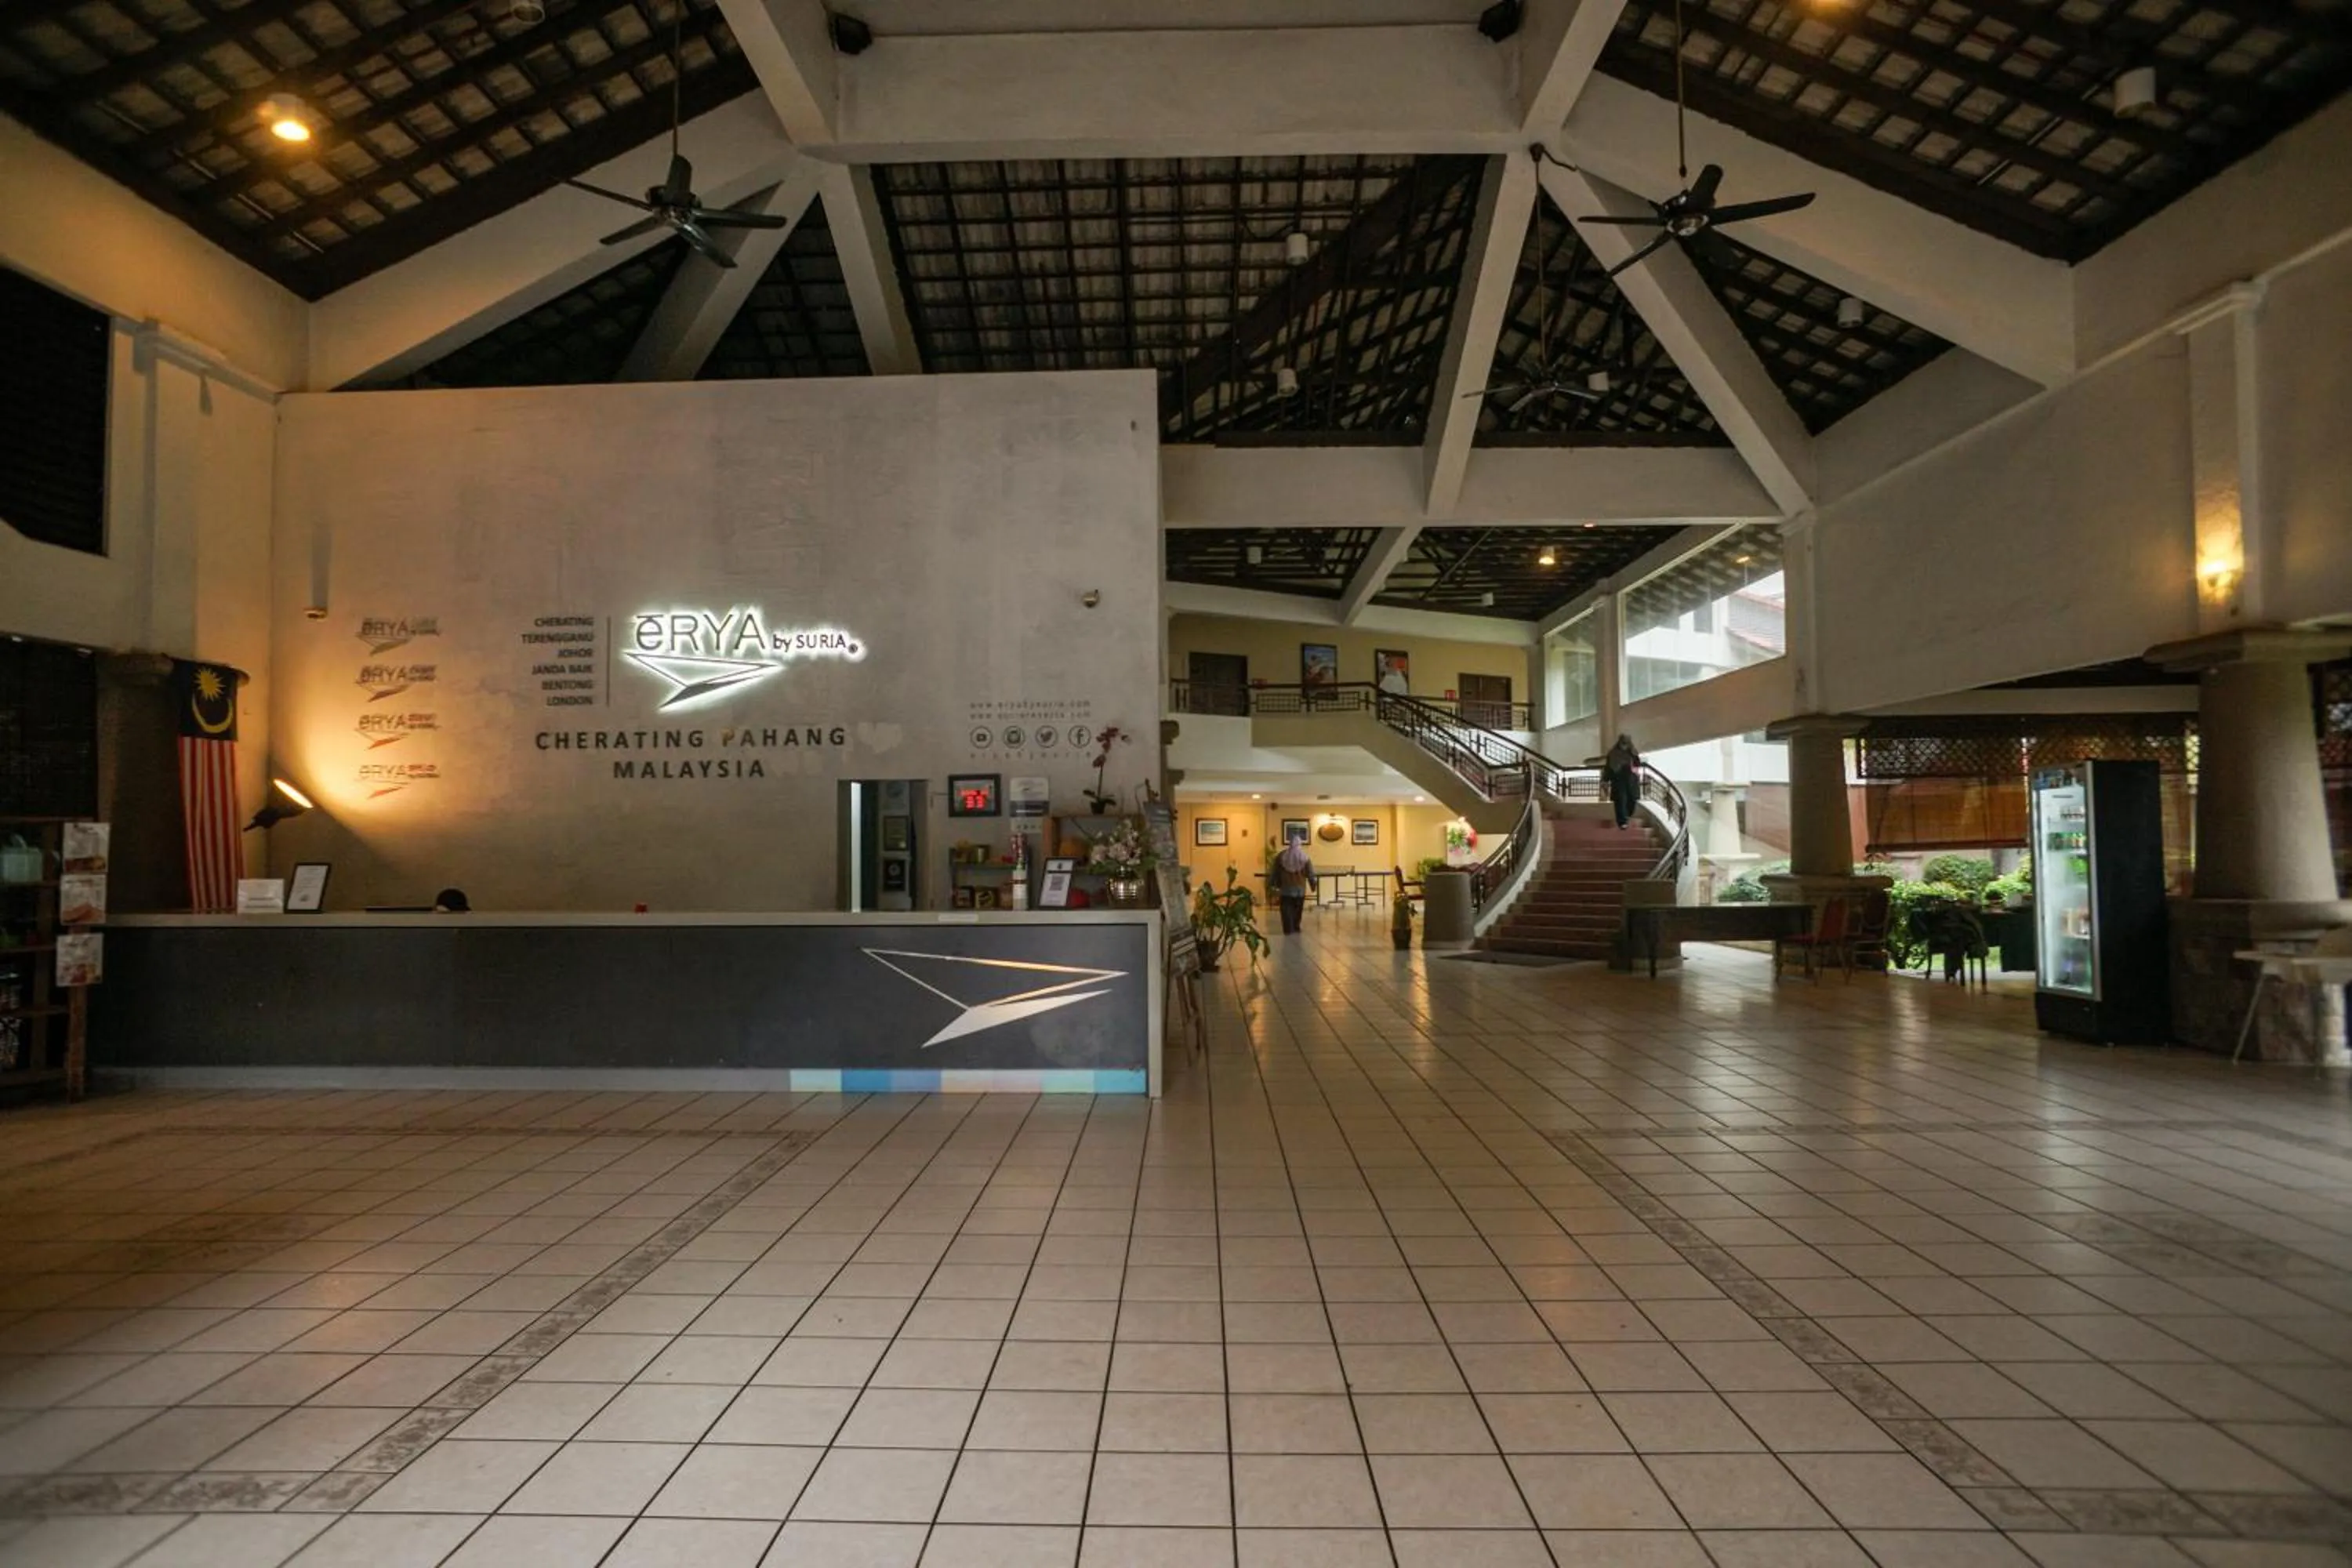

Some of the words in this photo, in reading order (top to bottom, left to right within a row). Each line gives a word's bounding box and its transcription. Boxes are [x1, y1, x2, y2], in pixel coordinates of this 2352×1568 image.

[534, 617, 594, 627] CHERATING
[773, 634, 790, 653] by
[795, 633, 847, 649] SURIA
[557, 648, 593, 659] JOHOR
[532, 664, 566, 675] JANDA
[542, 680, 593, 690] BENTONG
[546, 695, 593, 706] LONDON
[535, 730, 704, 750] CHERATING
[720, 727, 846, 748] PAHANG
[612, 760, 765, 779] MALAYSIA
